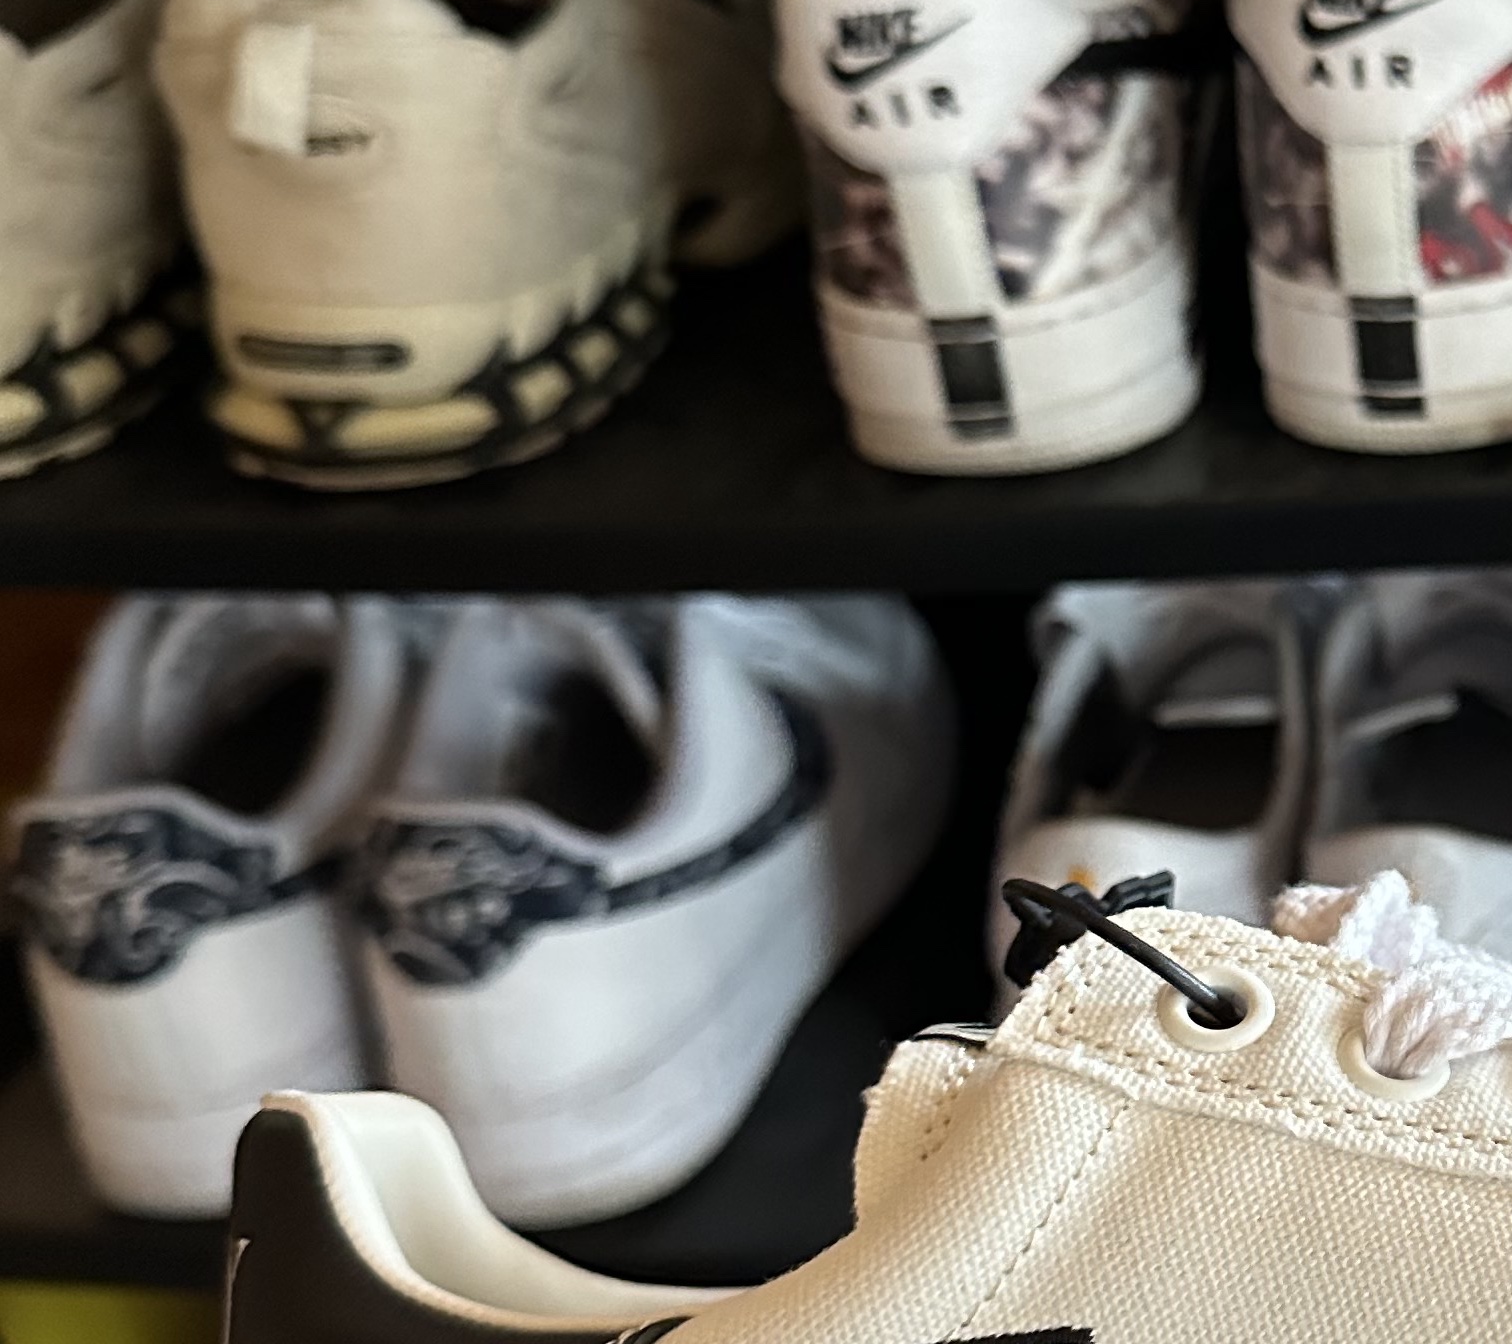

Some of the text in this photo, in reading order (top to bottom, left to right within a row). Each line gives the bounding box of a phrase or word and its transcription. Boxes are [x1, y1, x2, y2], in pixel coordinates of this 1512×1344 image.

[837, 6, 921, 54] NIKE
[1306, 54, 1414, 90] AIR
[851, 84, 961, 129] AIR
